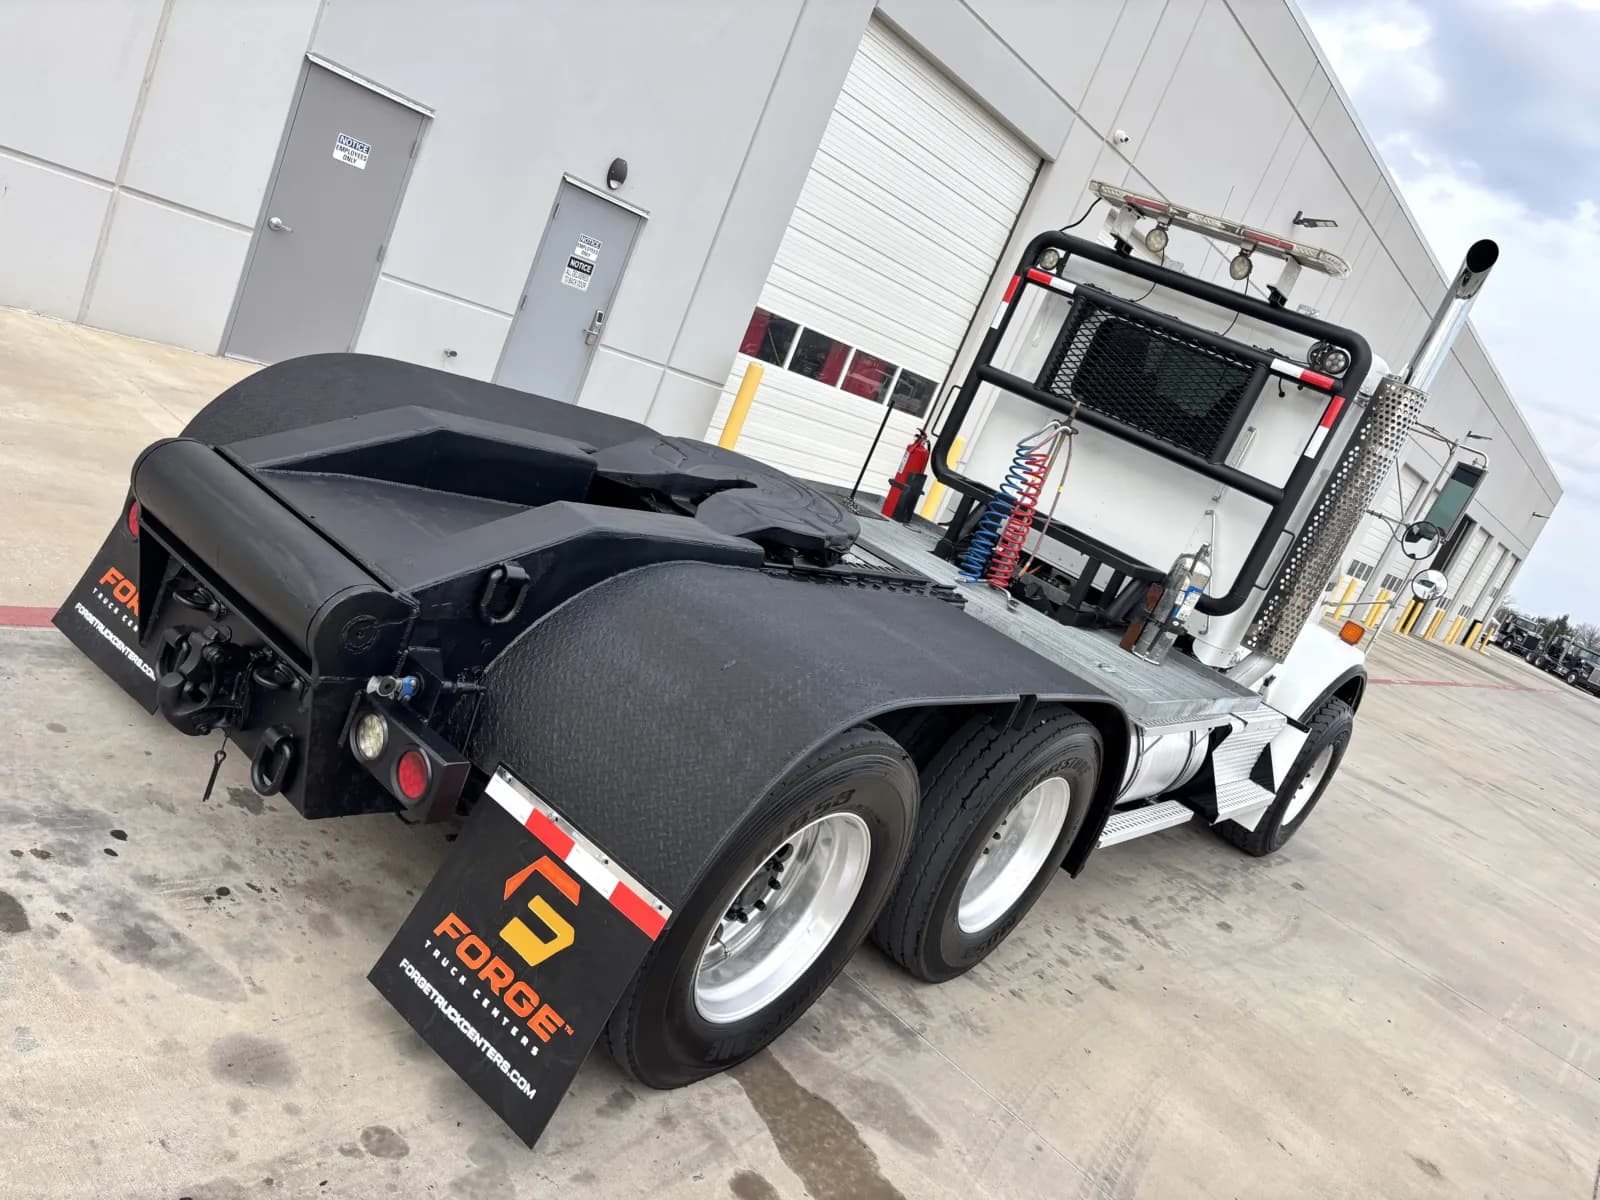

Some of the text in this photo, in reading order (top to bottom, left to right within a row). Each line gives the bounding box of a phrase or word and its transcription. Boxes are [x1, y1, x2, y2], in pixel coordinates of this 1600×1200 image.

[336, 144, 367, 161] EMPLOYEES
[339, 135, 368, 154] NOTICE
[343, 154, 357, 164] ONLY
[580, 235, 600, 250] NOTICE
[569, 258, 592, 273] NOTICE
[433, 912, 566, 1043] FORGE
[424, 939, 539, 1057] TRUCK CENTERS
[399, 958, 537, 1100] FORGETRUCKCENTERS.COM
